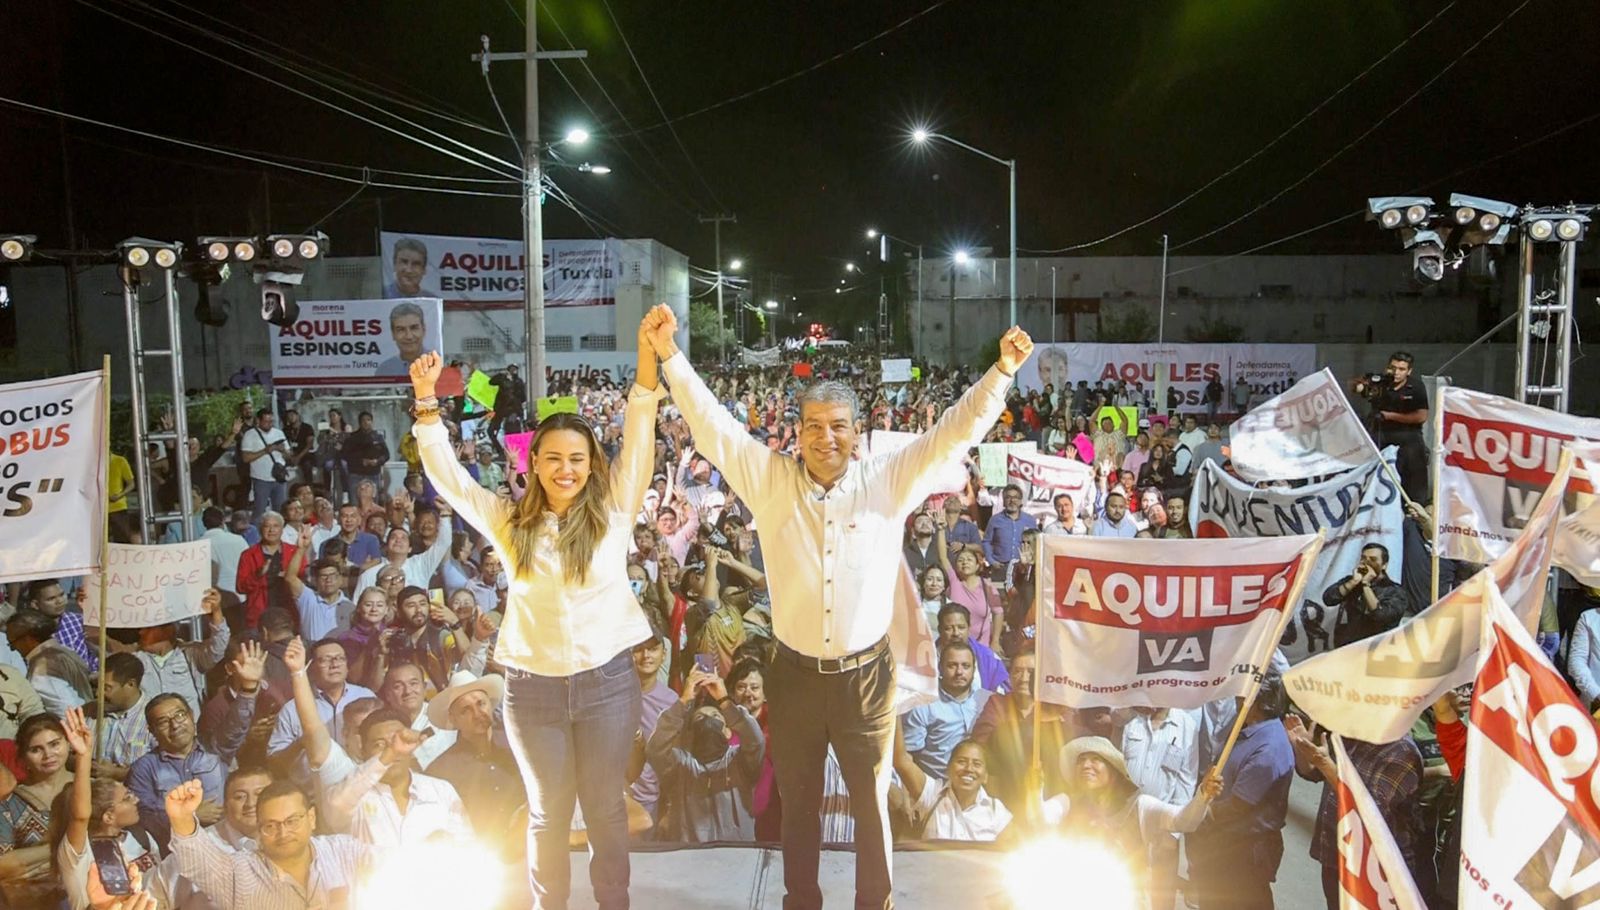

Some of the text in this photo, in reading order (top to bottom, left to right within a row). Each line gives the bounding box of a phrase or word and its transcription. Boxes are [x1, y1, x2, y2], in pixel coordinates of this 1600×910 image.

[279, 319, 382, 340] AQUILES
[281, 341, 381, 356] ESPINOSA
[352, 361, 378, 369] Tuxtla
[1101, 363, 1220, 386] AQULES
[143, 569, 200, 593] JOSE
[122, 594, 162, 607] CON
[1063, 565, 1291, 624] AQUILES
[1145, 637, 1205, 667] VA
[1045, 675, 1128, 694] Defendamos
[1147, 678, 1208, 690] progreso
[1212, 676, 1227, 687] de
